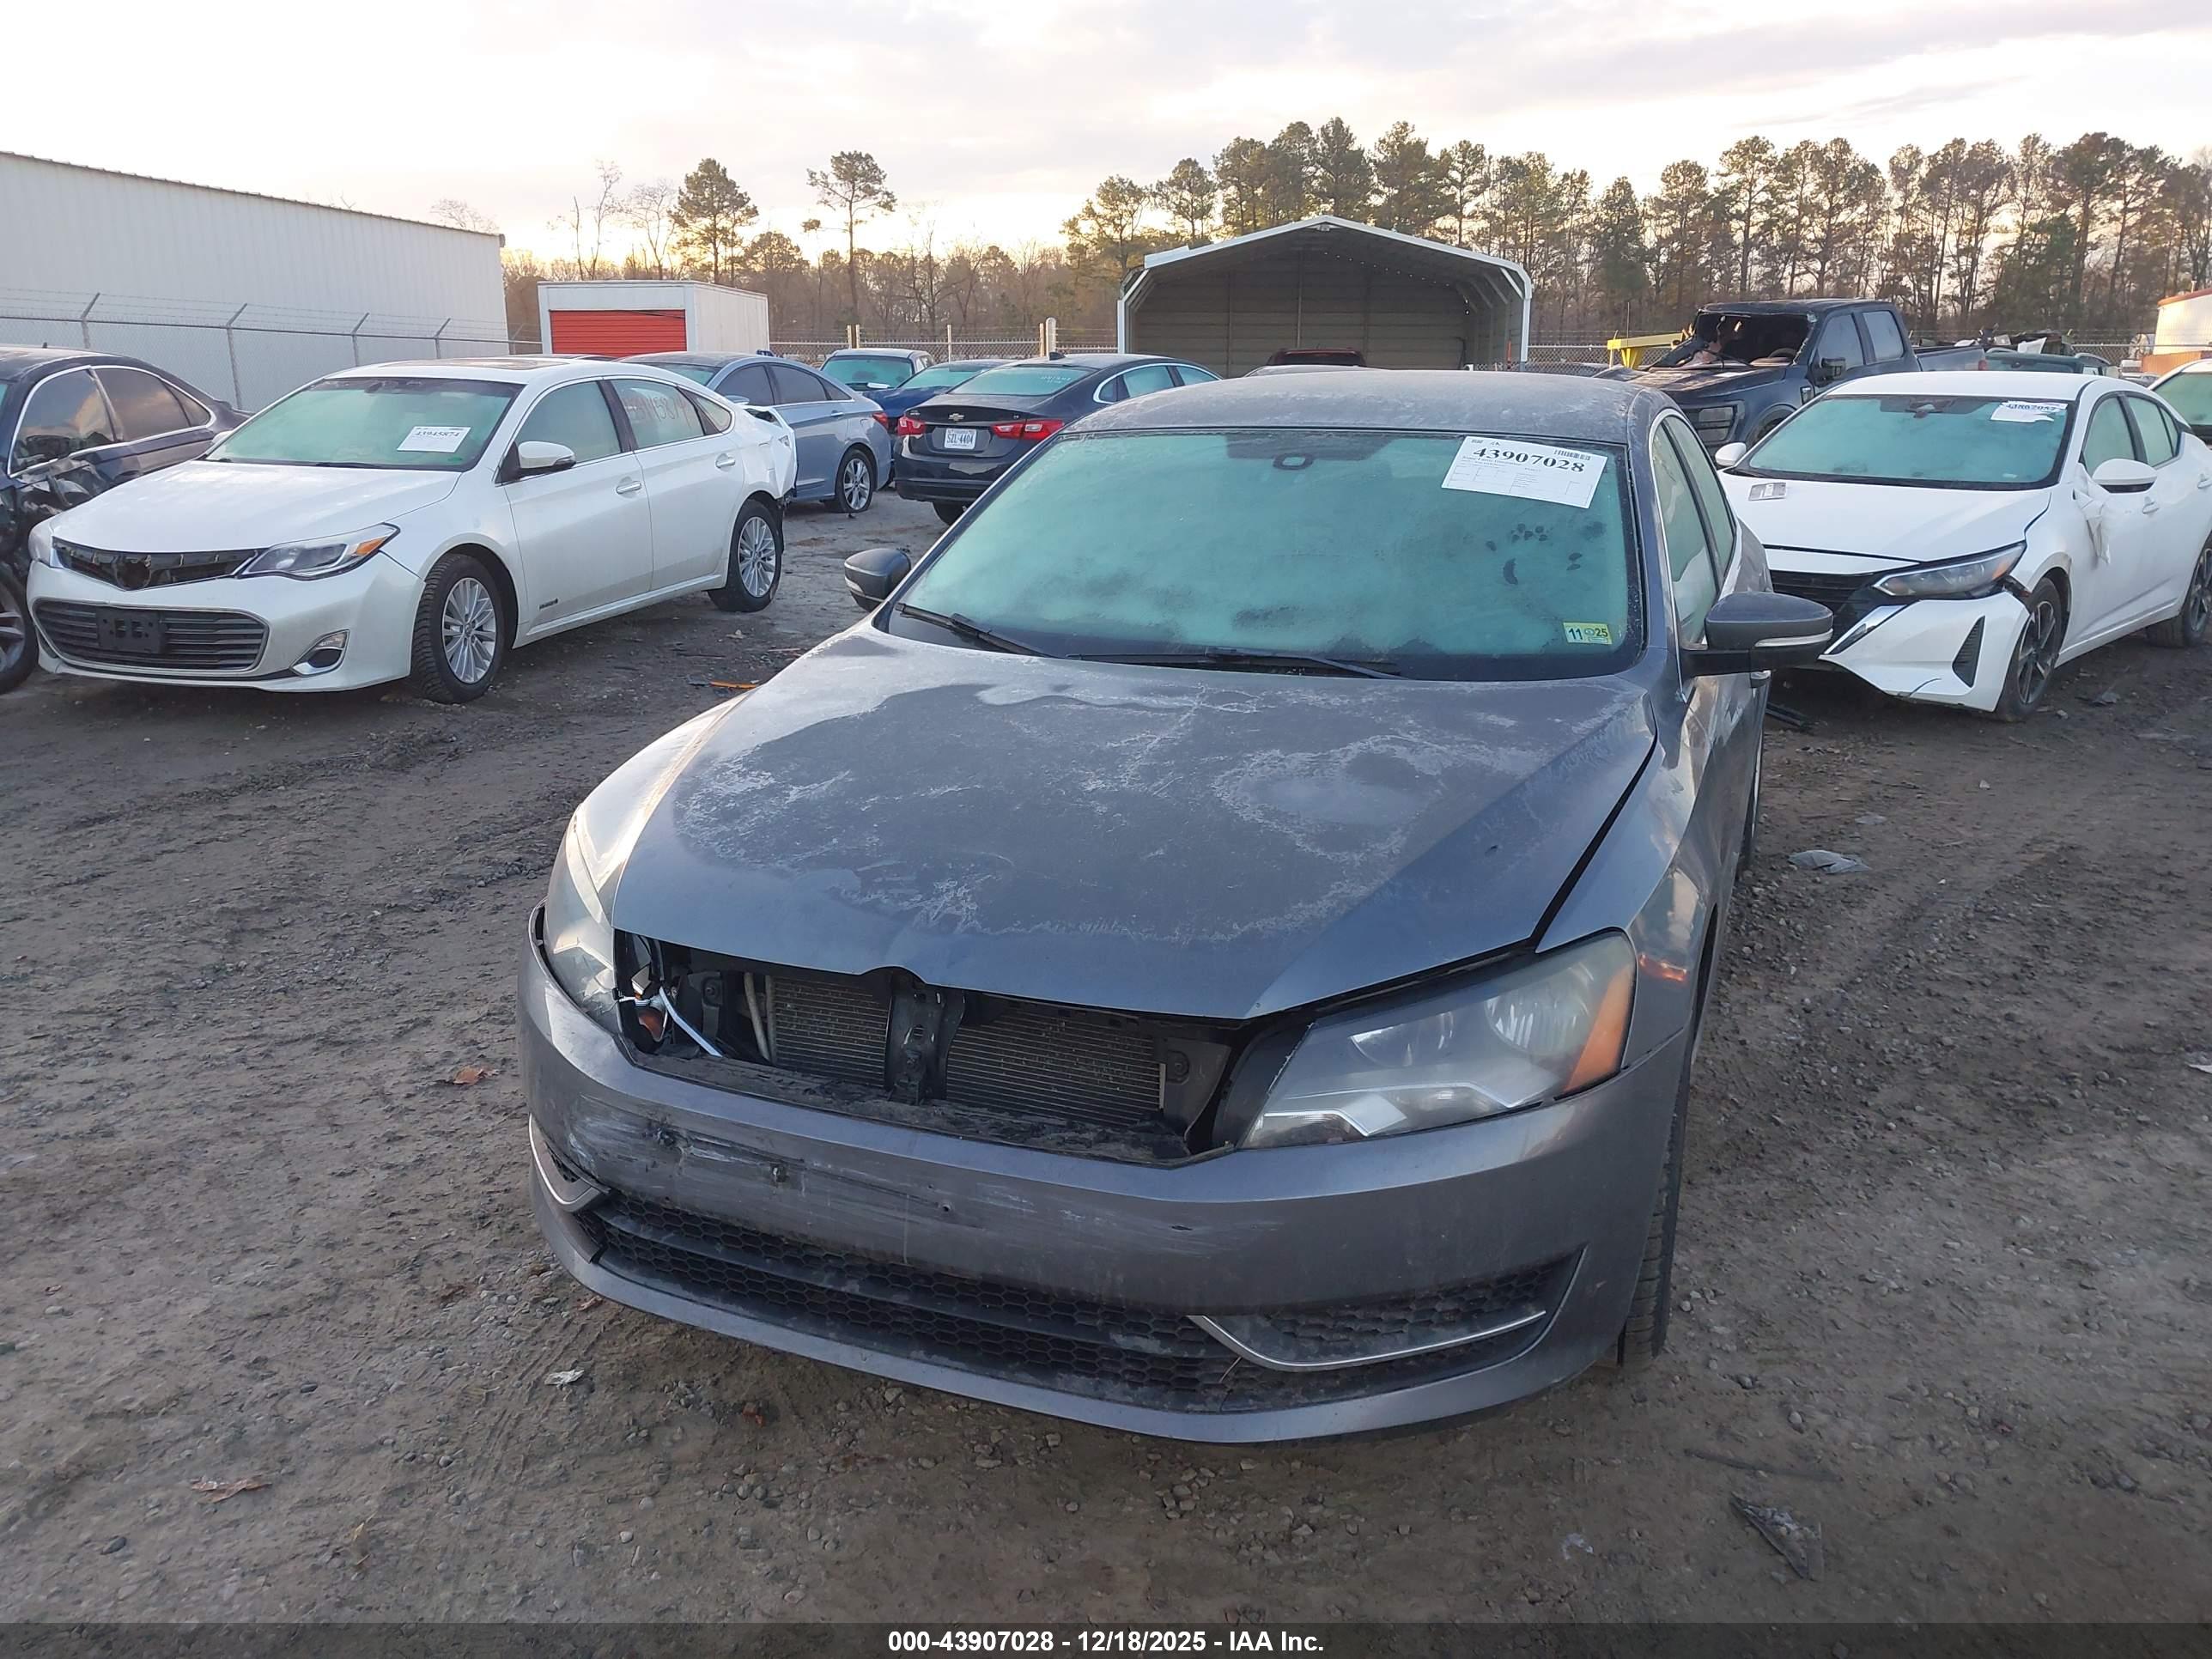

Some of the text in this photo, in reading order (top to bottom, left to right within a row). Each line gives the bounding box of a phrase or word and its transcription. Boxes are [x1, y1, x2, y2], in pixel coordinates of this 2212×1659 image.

[1473, 447, 1585, 473] 43907028
[1568, 628, 1608, 641] 11 25
